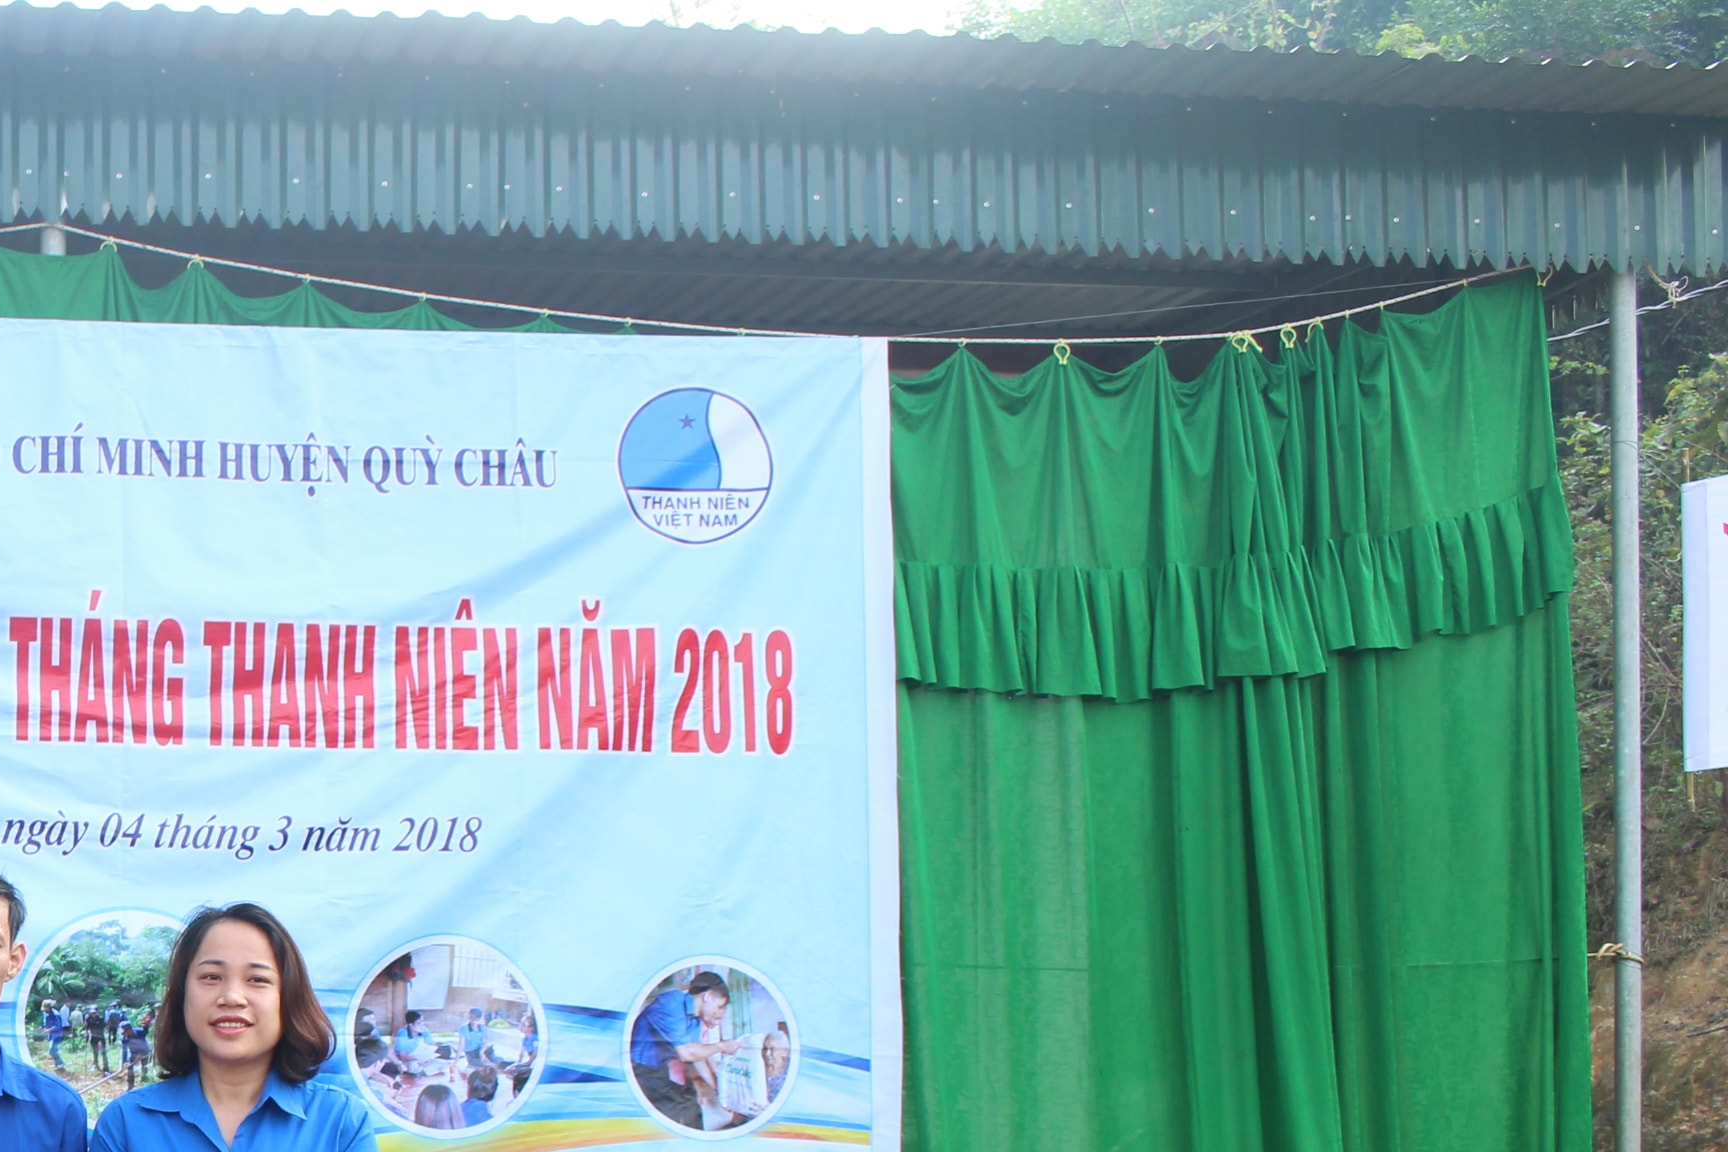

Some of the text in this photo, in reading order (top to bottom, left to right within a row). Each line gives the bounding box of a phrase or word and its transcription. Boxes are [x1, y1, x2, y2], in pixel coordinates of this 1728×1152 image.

[12, 422, 84, 474] CHÍ
[97, 437, 206, 477] MINH
[217, 432, 351, 497] HUYỆN
[363, 434, 443, 494] QUỲ
[454, 437, 559, 488] CHÂU
[642, 493, 750, 510] THANH NIÊN
[653, 511, 738, 529] VIỆT NAM
[9, 590, 184, 746] THÁNG
[203, 621, 376, 749] THANH
[394, 599, 518, 750] NIÊN
[537, 599, 655, 752] NĂM
[671, 628, 793, 755] 2018
[1, 810, 89, 856] ngày
[99, 812, 145, 847] 04
[153, 813, 260, 860] tháng
[268, 815, 293, 851] 3
[301, 816, 381, 852] năm
[392, 816, 482, 852] 2018
